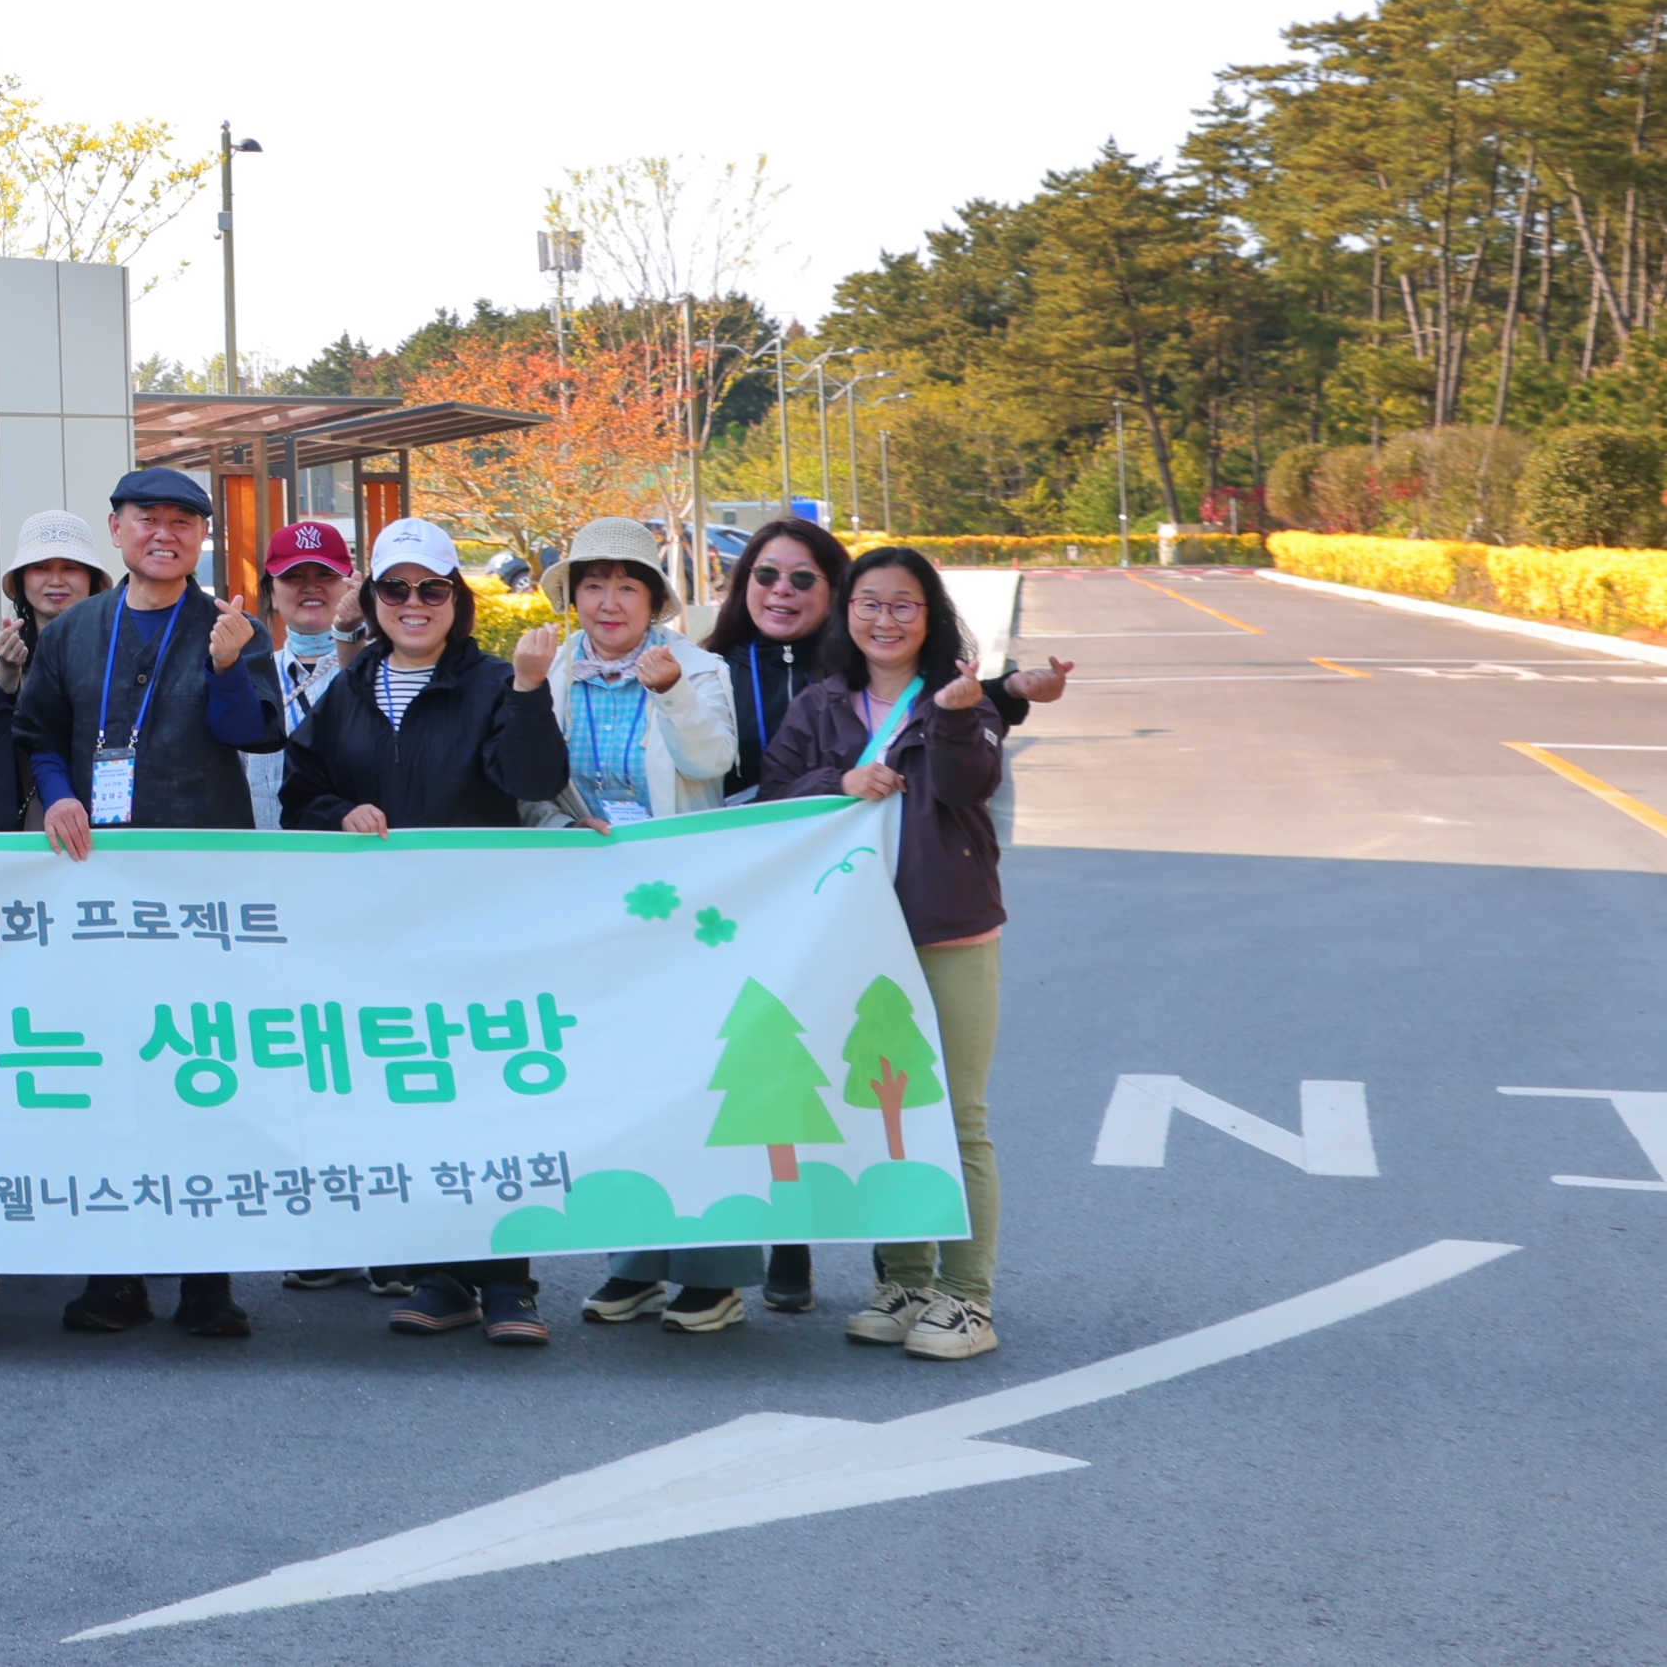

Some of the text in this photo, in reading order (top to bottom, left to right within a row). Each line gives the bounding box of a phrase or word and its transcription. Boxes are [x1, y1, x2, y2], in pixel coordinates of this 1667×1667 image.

[71, 900, 288, 952] 프로젝트
[138, 992, 577, 1108] 생태탐방
[430, 1150, 574, 1200] 학생회
